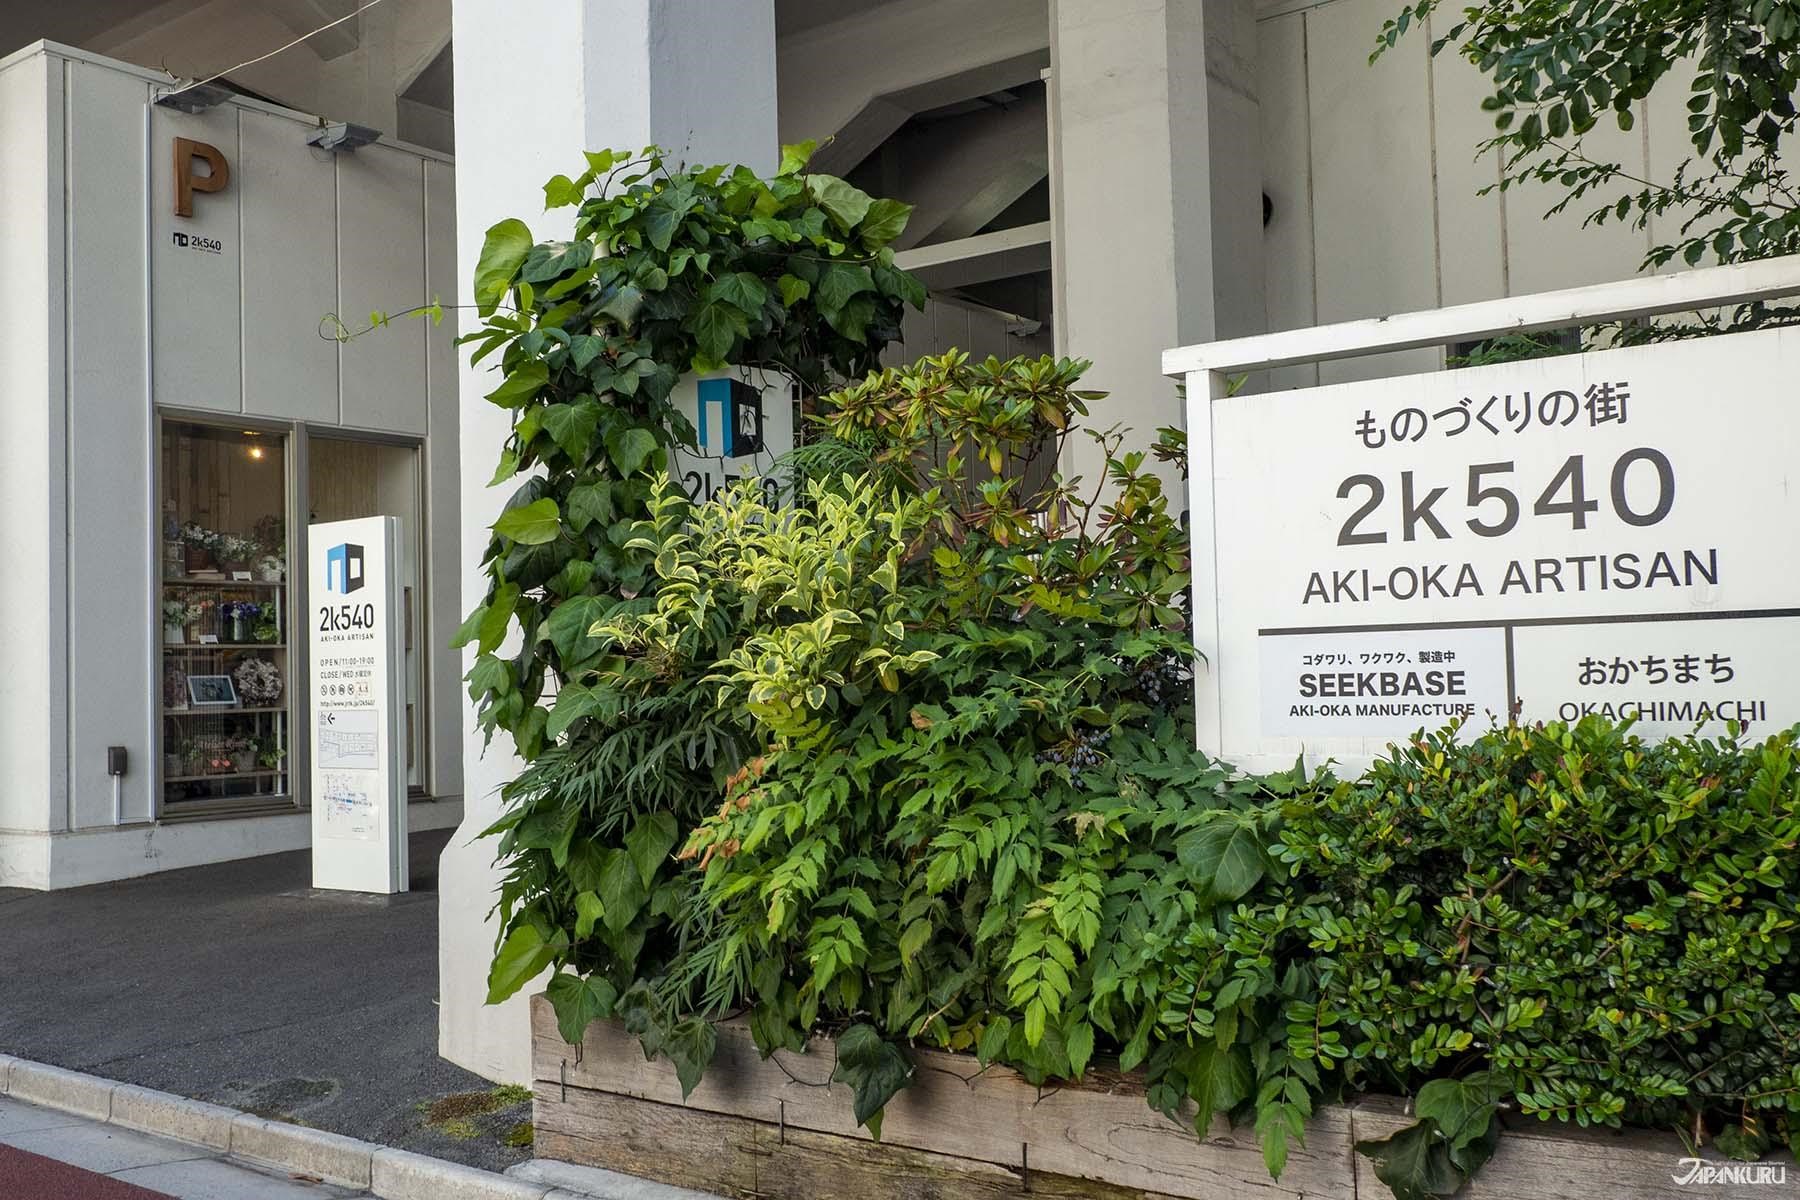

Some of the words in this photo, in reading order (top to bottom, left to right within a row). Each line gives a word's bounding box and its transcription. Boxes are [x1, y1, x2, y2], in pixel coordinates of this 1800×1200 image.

[173, 136, 230, 218] P
[191, 235, 222, 251] 2k540
[1355, 381, 1631, 449] ものづくりの街
[1335, 446, 1676, 547] 2k540
[1302, 563, 1484, 604] AKI-OKA
[1499, 549, 1719, 595] ARTISAN
[319, 603, 374, 632] 2k540
[347, 632, 374, 641] ARTISAN
[1302, 650, 1456, 666] コダワリ、ワクワク、製造中
[1577, 653, 1735, 686] おかちまち
[1299, 670, 1467, 698] SEEKBASE
[1289, 704, 1352, 717] AKI-OKA
[1355, 703, 1476, 717] MANUFACTURE
